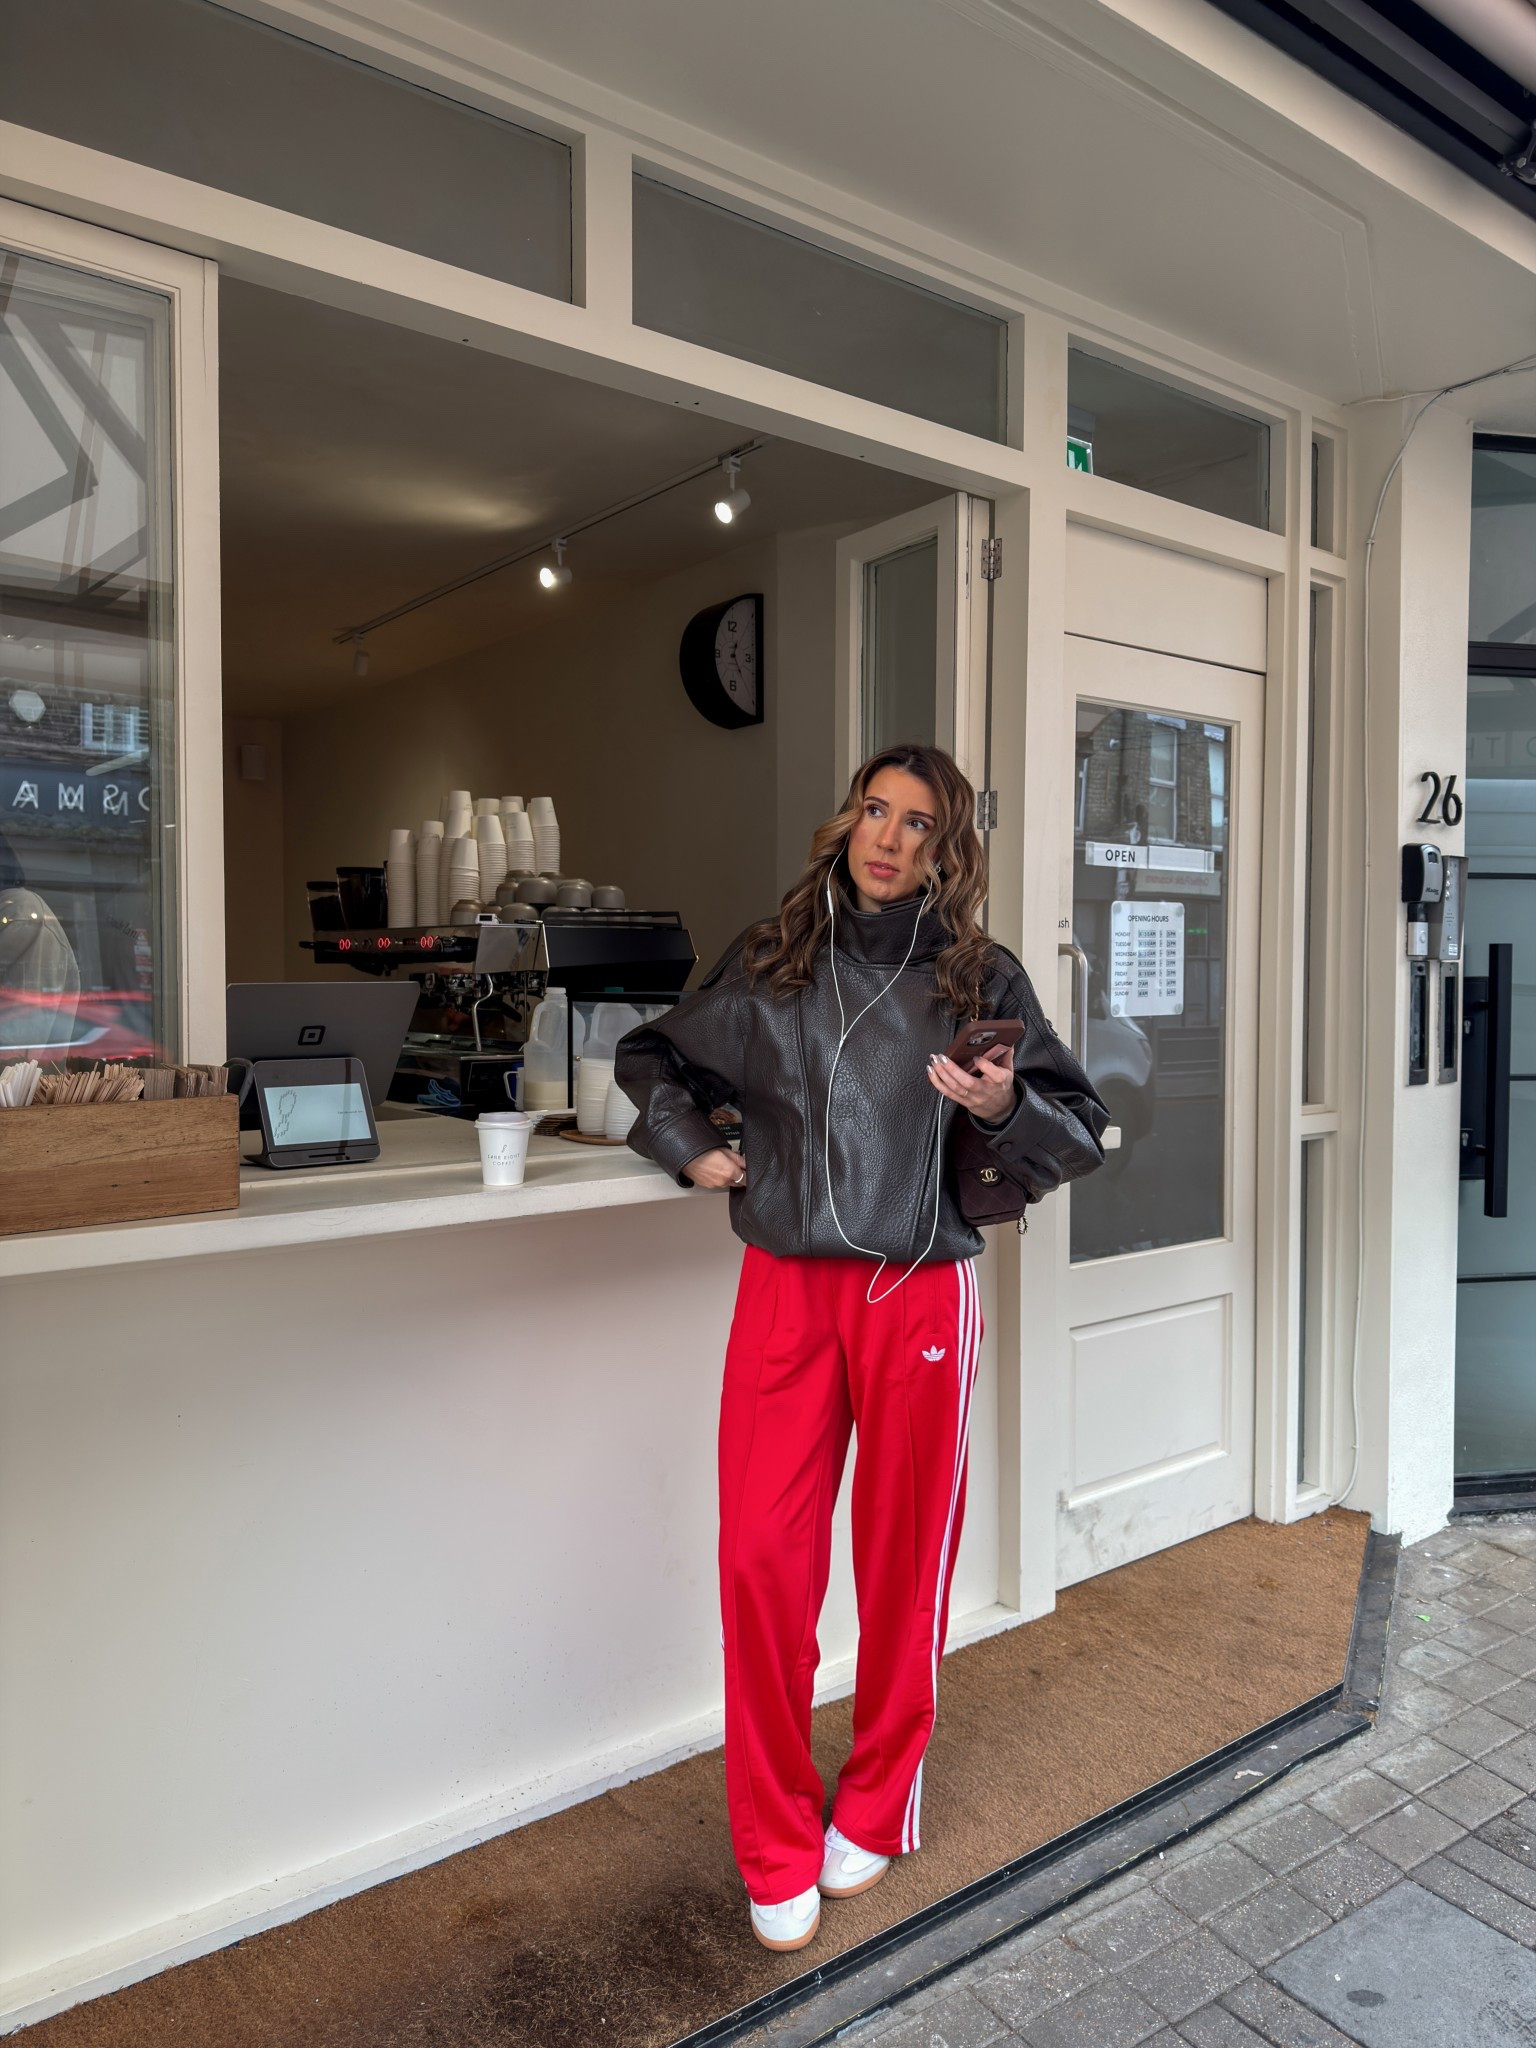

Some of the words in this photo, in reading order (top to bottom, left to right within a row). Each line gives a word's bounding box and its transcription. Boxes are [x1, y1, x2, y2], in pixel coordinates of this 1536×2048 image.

[727, 621, 737, 632] 12
[745, 653, 751, 663] 3
[730, 680, 737, 691] 6
[1416, 771, 1463, 826] 26
[1105, 849, 1136, 862] OPEN
